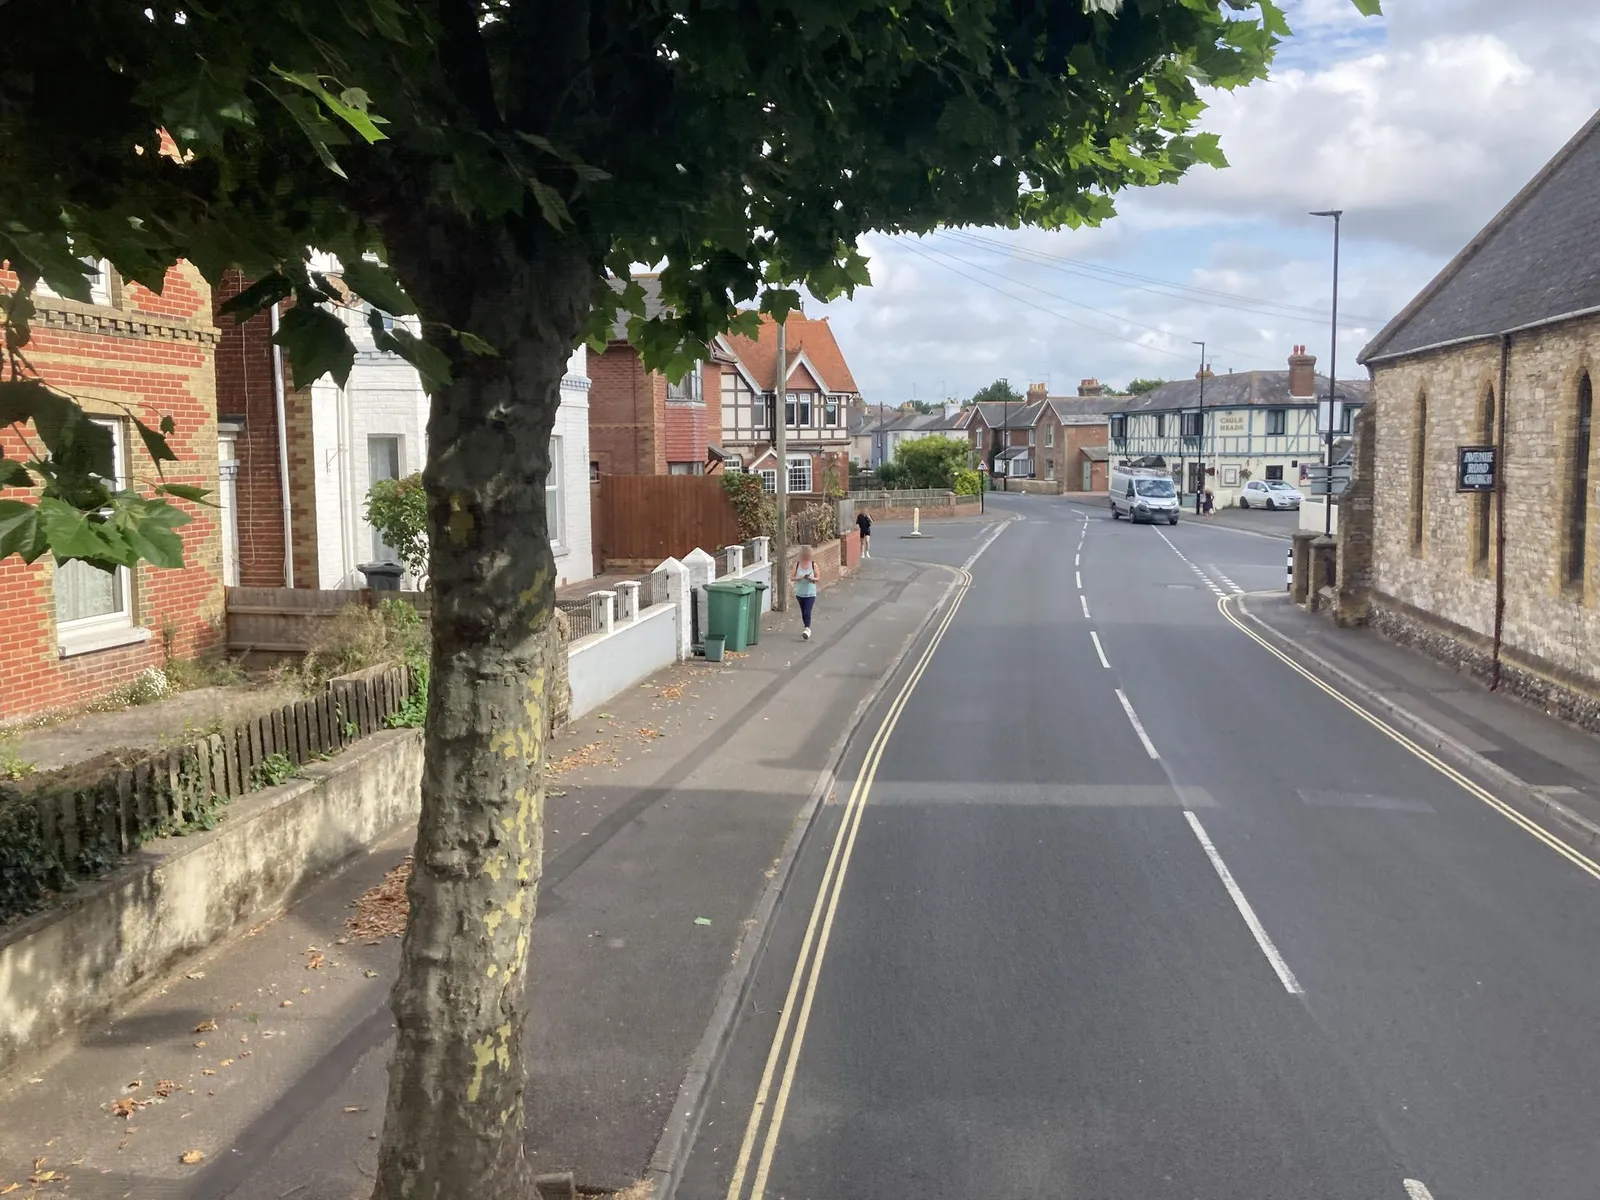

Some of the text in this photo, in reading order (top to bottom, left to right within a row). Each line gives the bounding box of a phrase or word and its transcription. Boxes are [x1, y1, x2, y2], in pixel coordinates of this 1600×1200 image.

[1464, 452, 1493, 463] AVENUE
[1467, 463, 1489, 473] ROAD
[1464, 474, 1492, 484] CHURCH
